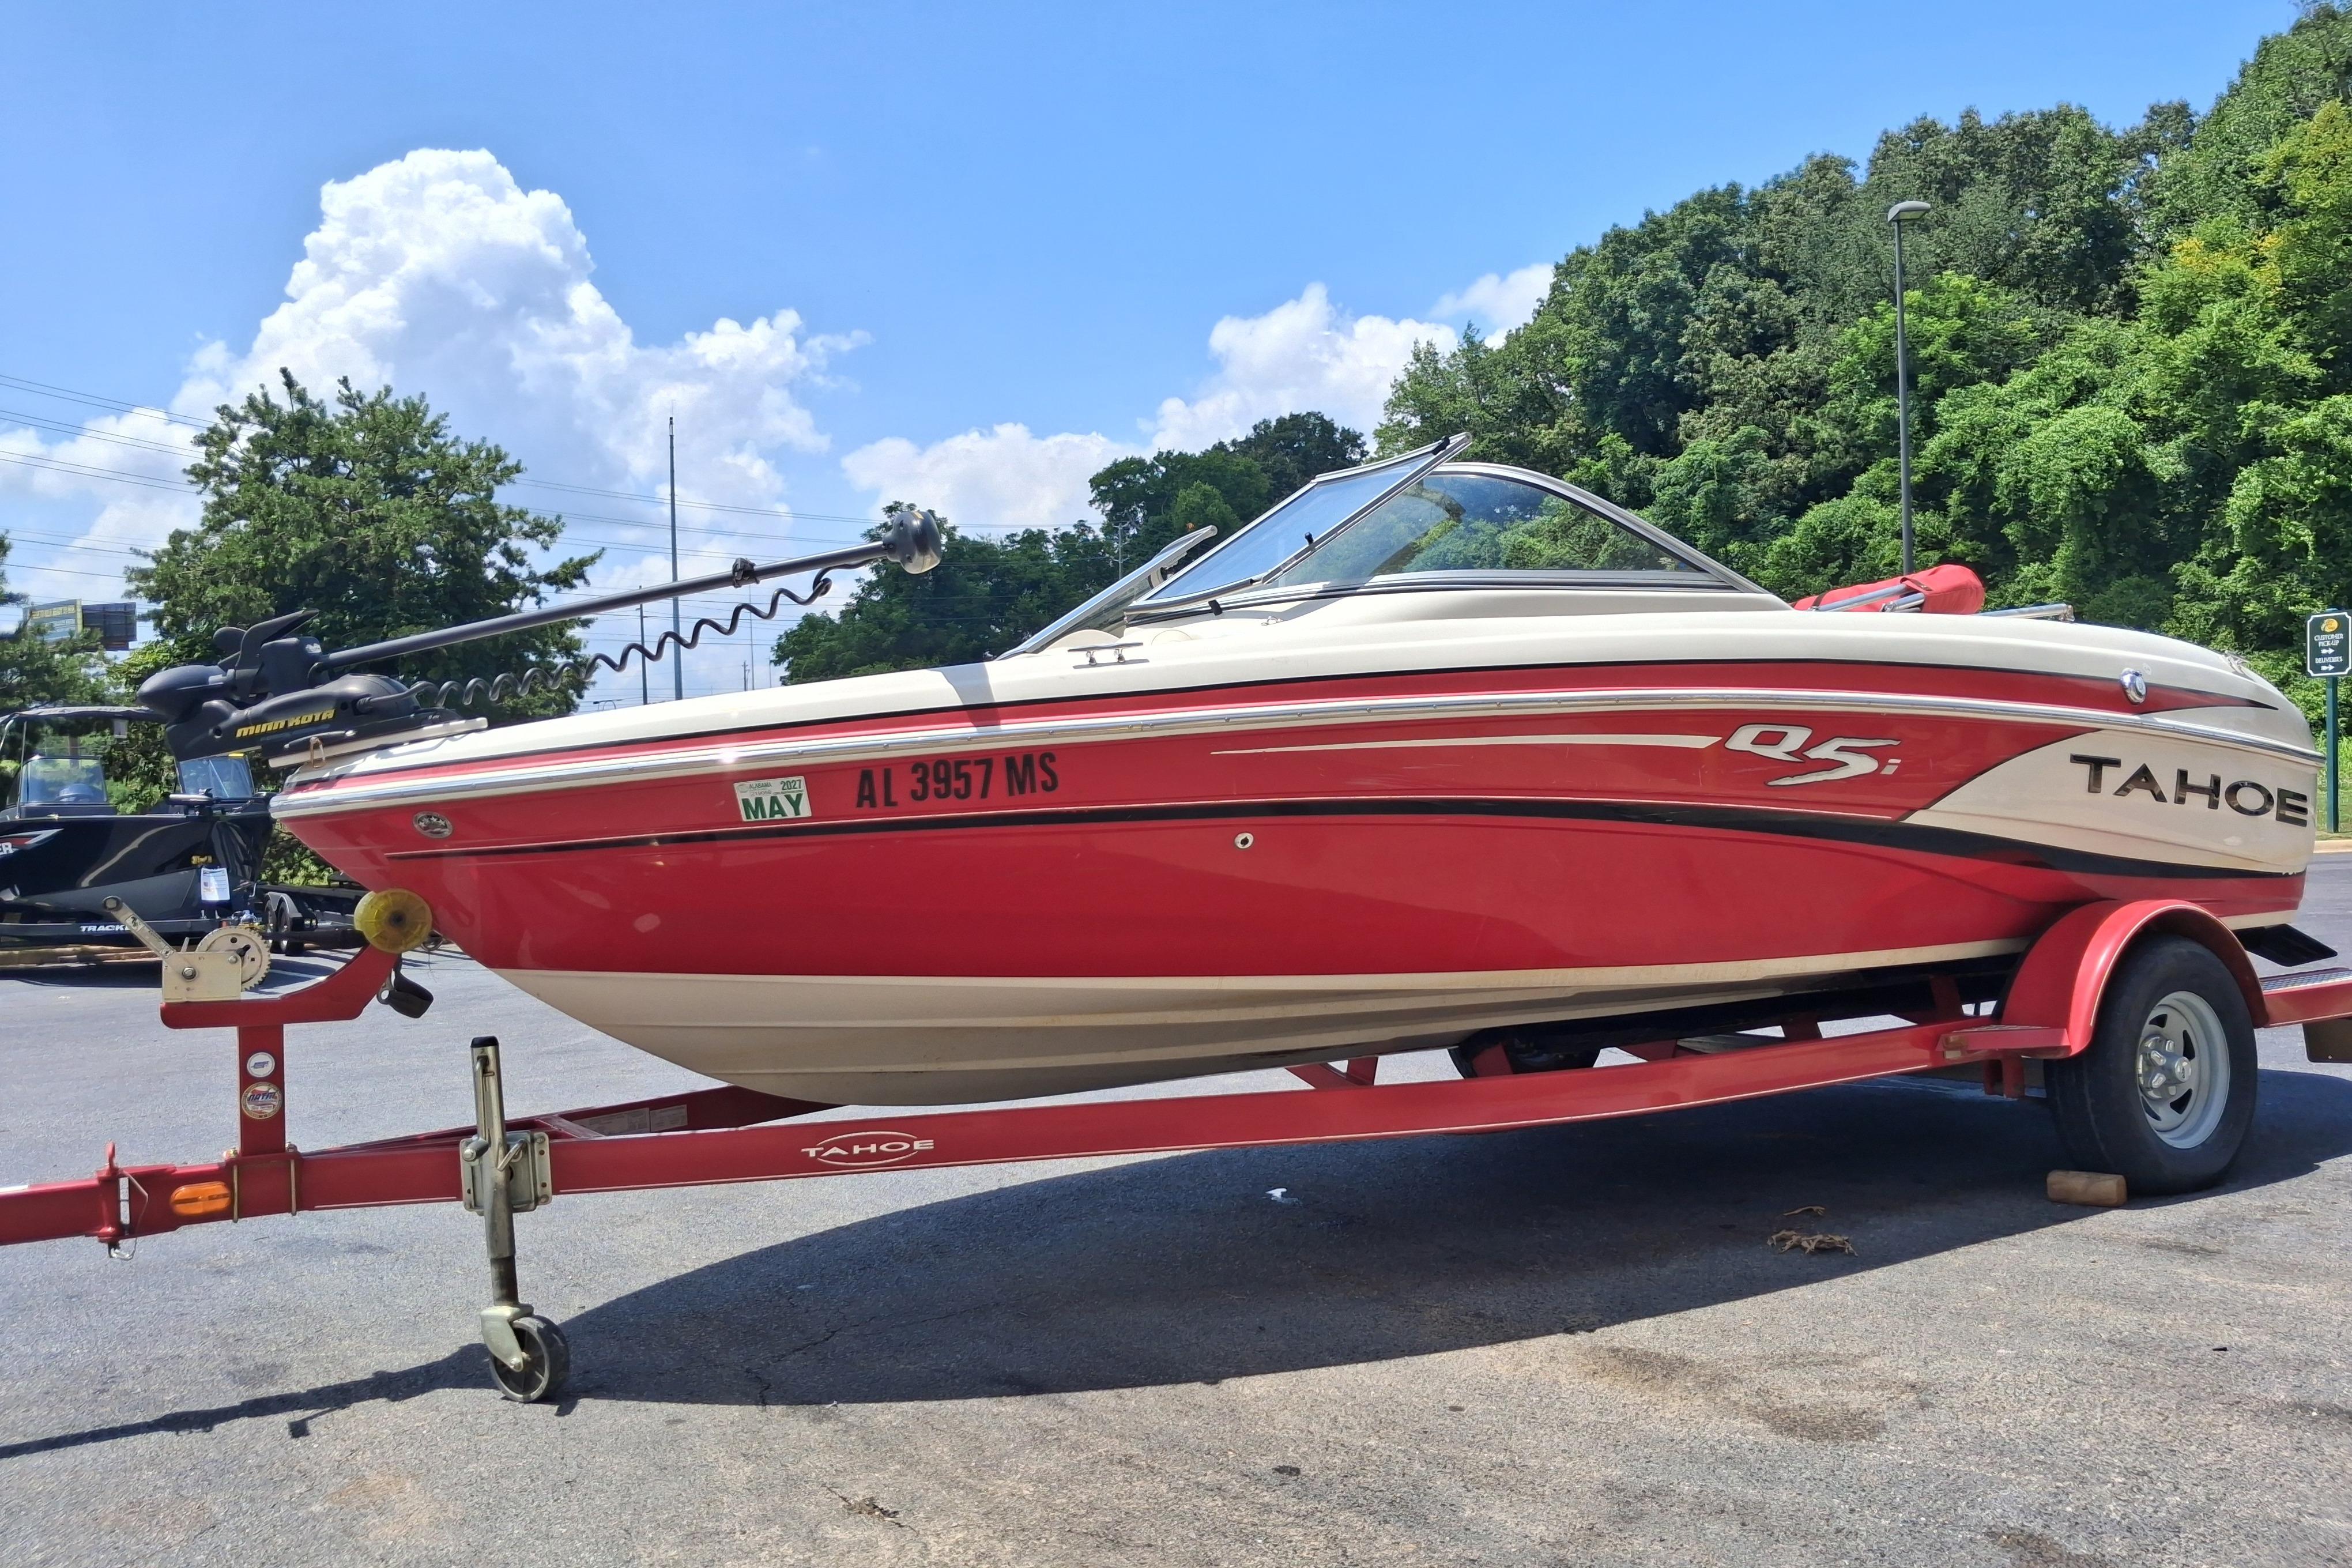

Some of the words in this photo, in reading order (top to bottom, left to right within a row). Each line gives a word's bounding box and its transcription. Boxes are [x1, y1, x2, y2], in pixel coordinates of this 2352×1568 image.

[288, 708, 336, 727] KOTA
[780, 779, 802, 790] 2027
[856, 768, 898, 808] AL
[910, 757, 993, 801] 3957
[1005, 752, 1059, 796] MS
[2070, 753, 2308, 827] TAHOE
[741, 793, 803, 820] MAY
[801, 1139, 934, 1158] TAHOE
